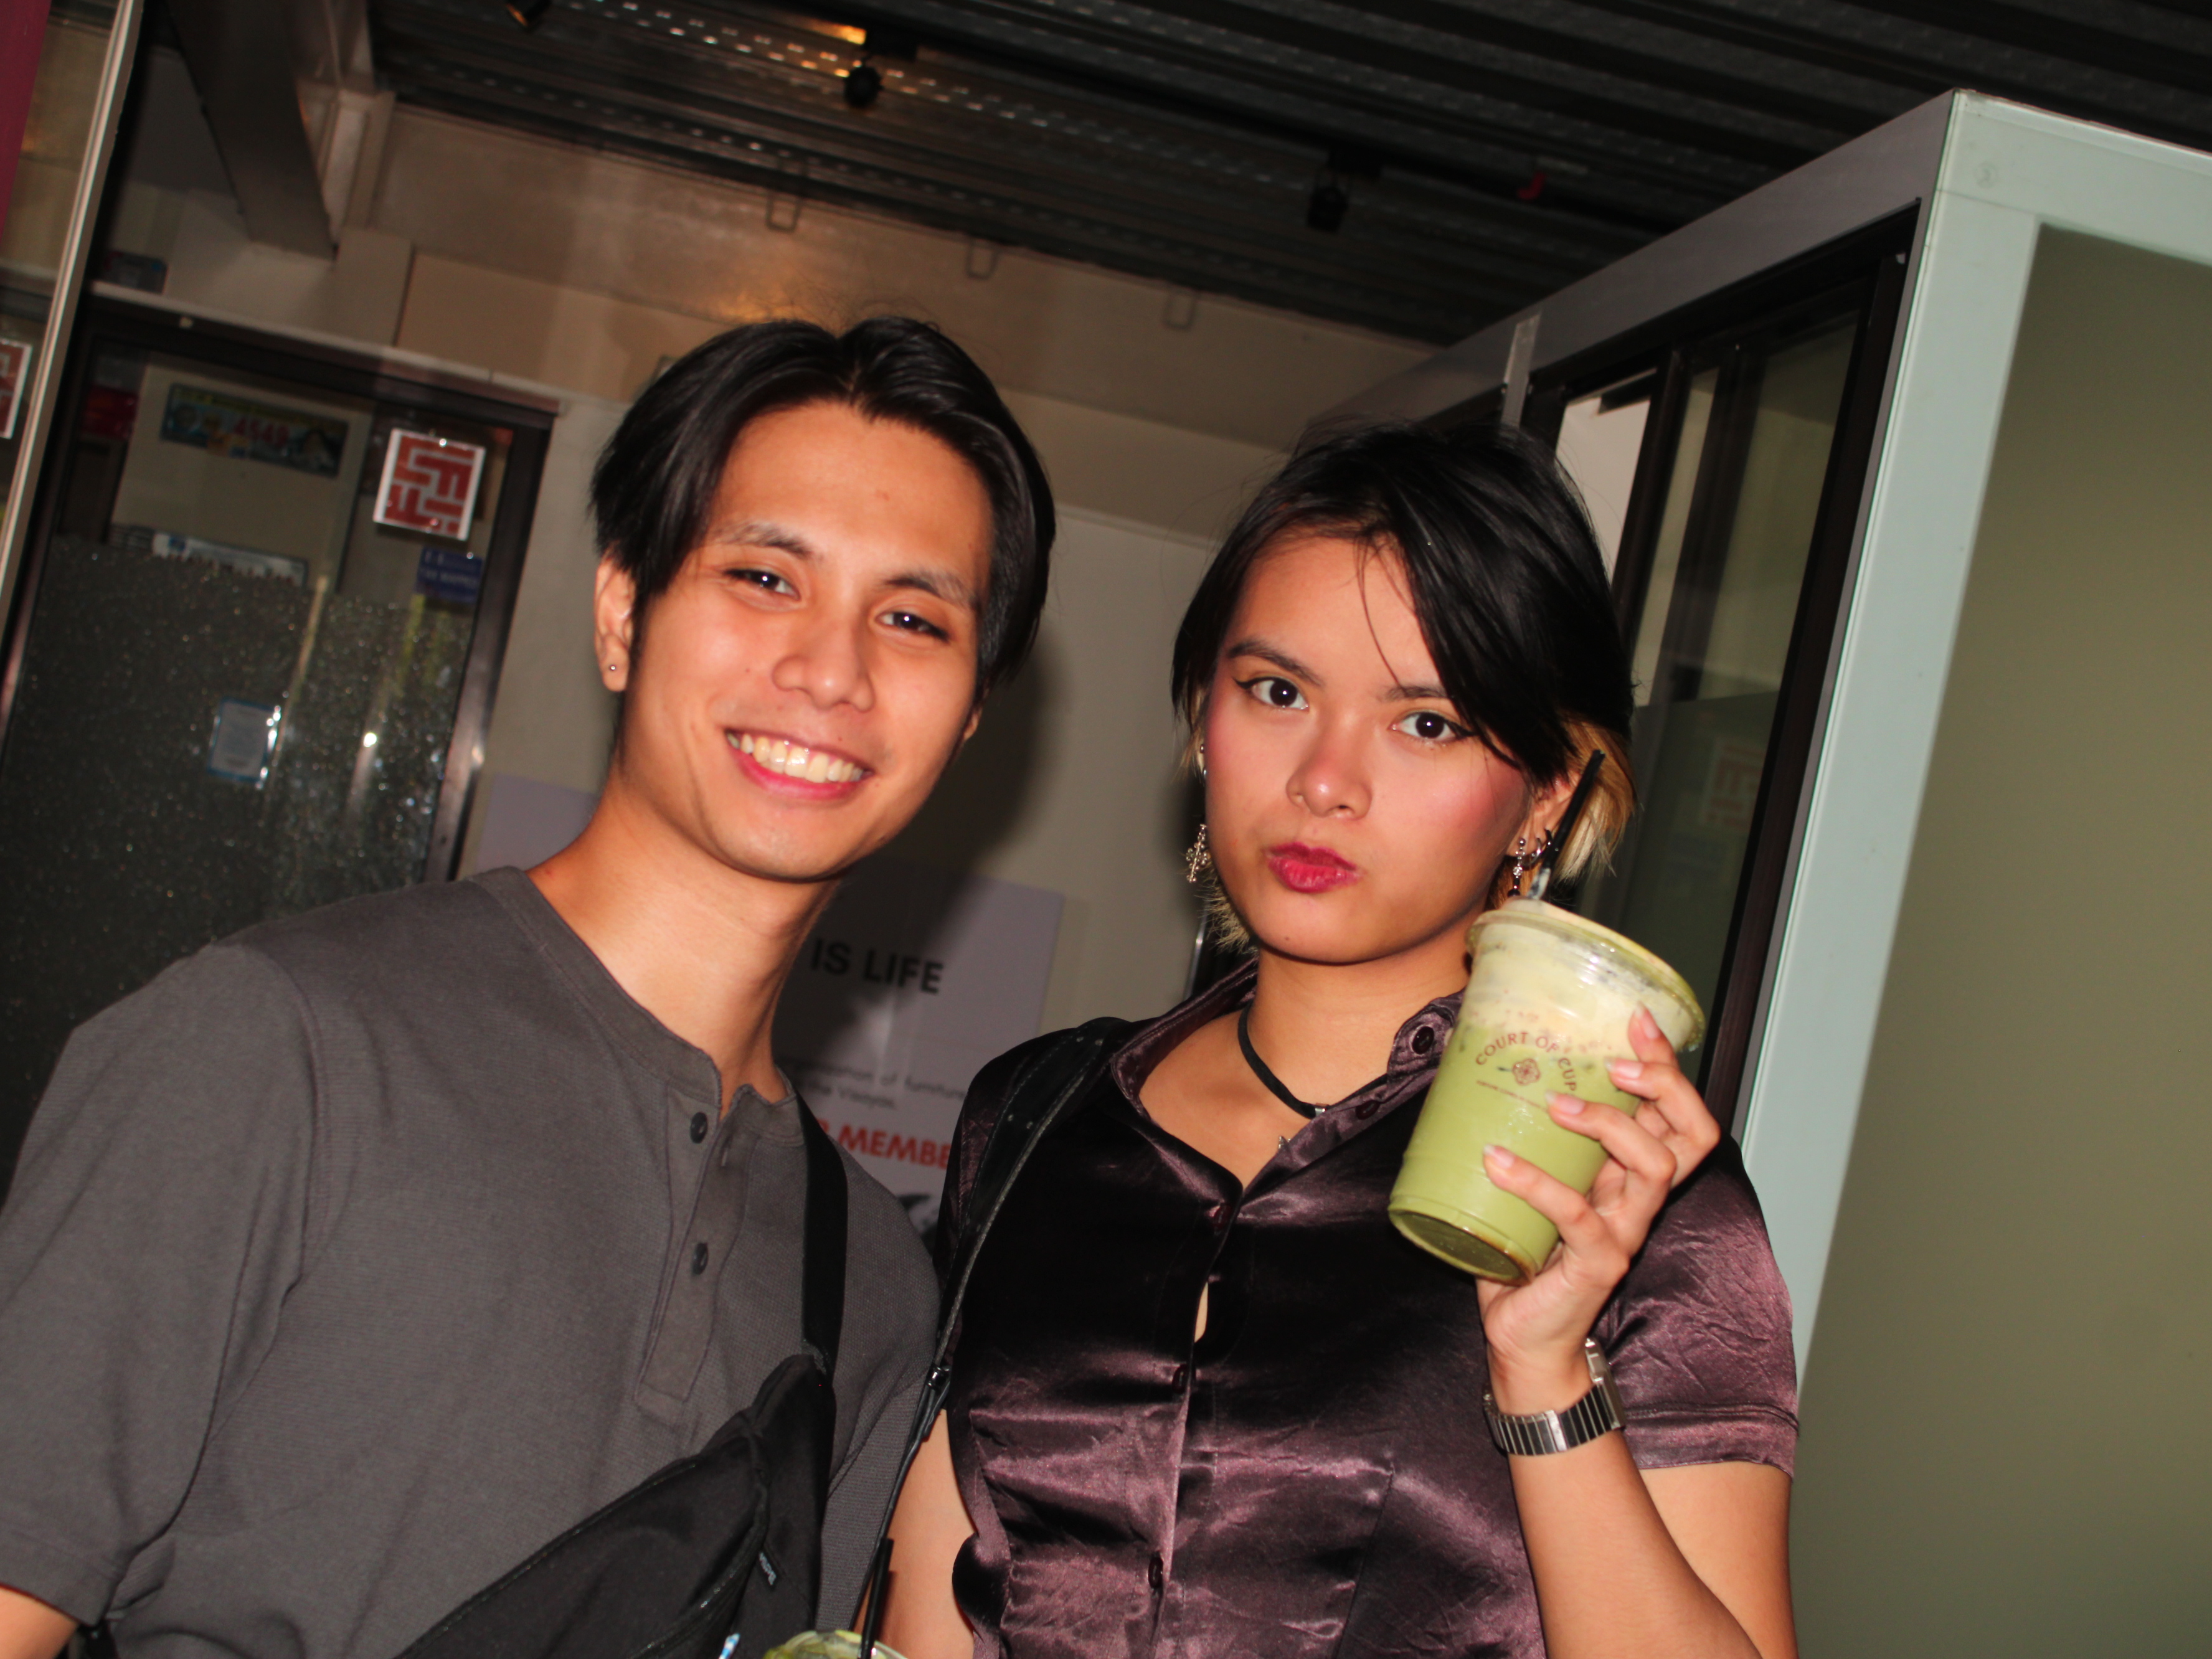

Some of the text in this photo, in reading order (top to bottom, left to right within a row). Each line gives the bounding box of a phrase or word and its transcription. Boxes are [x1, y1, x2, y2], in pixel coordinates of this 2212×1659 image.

[810, 937, 943, 994] IS LIFE
[1476, 1031, 1529, 1066] COURT
[1535, 1036, 1559, 1053] OF
